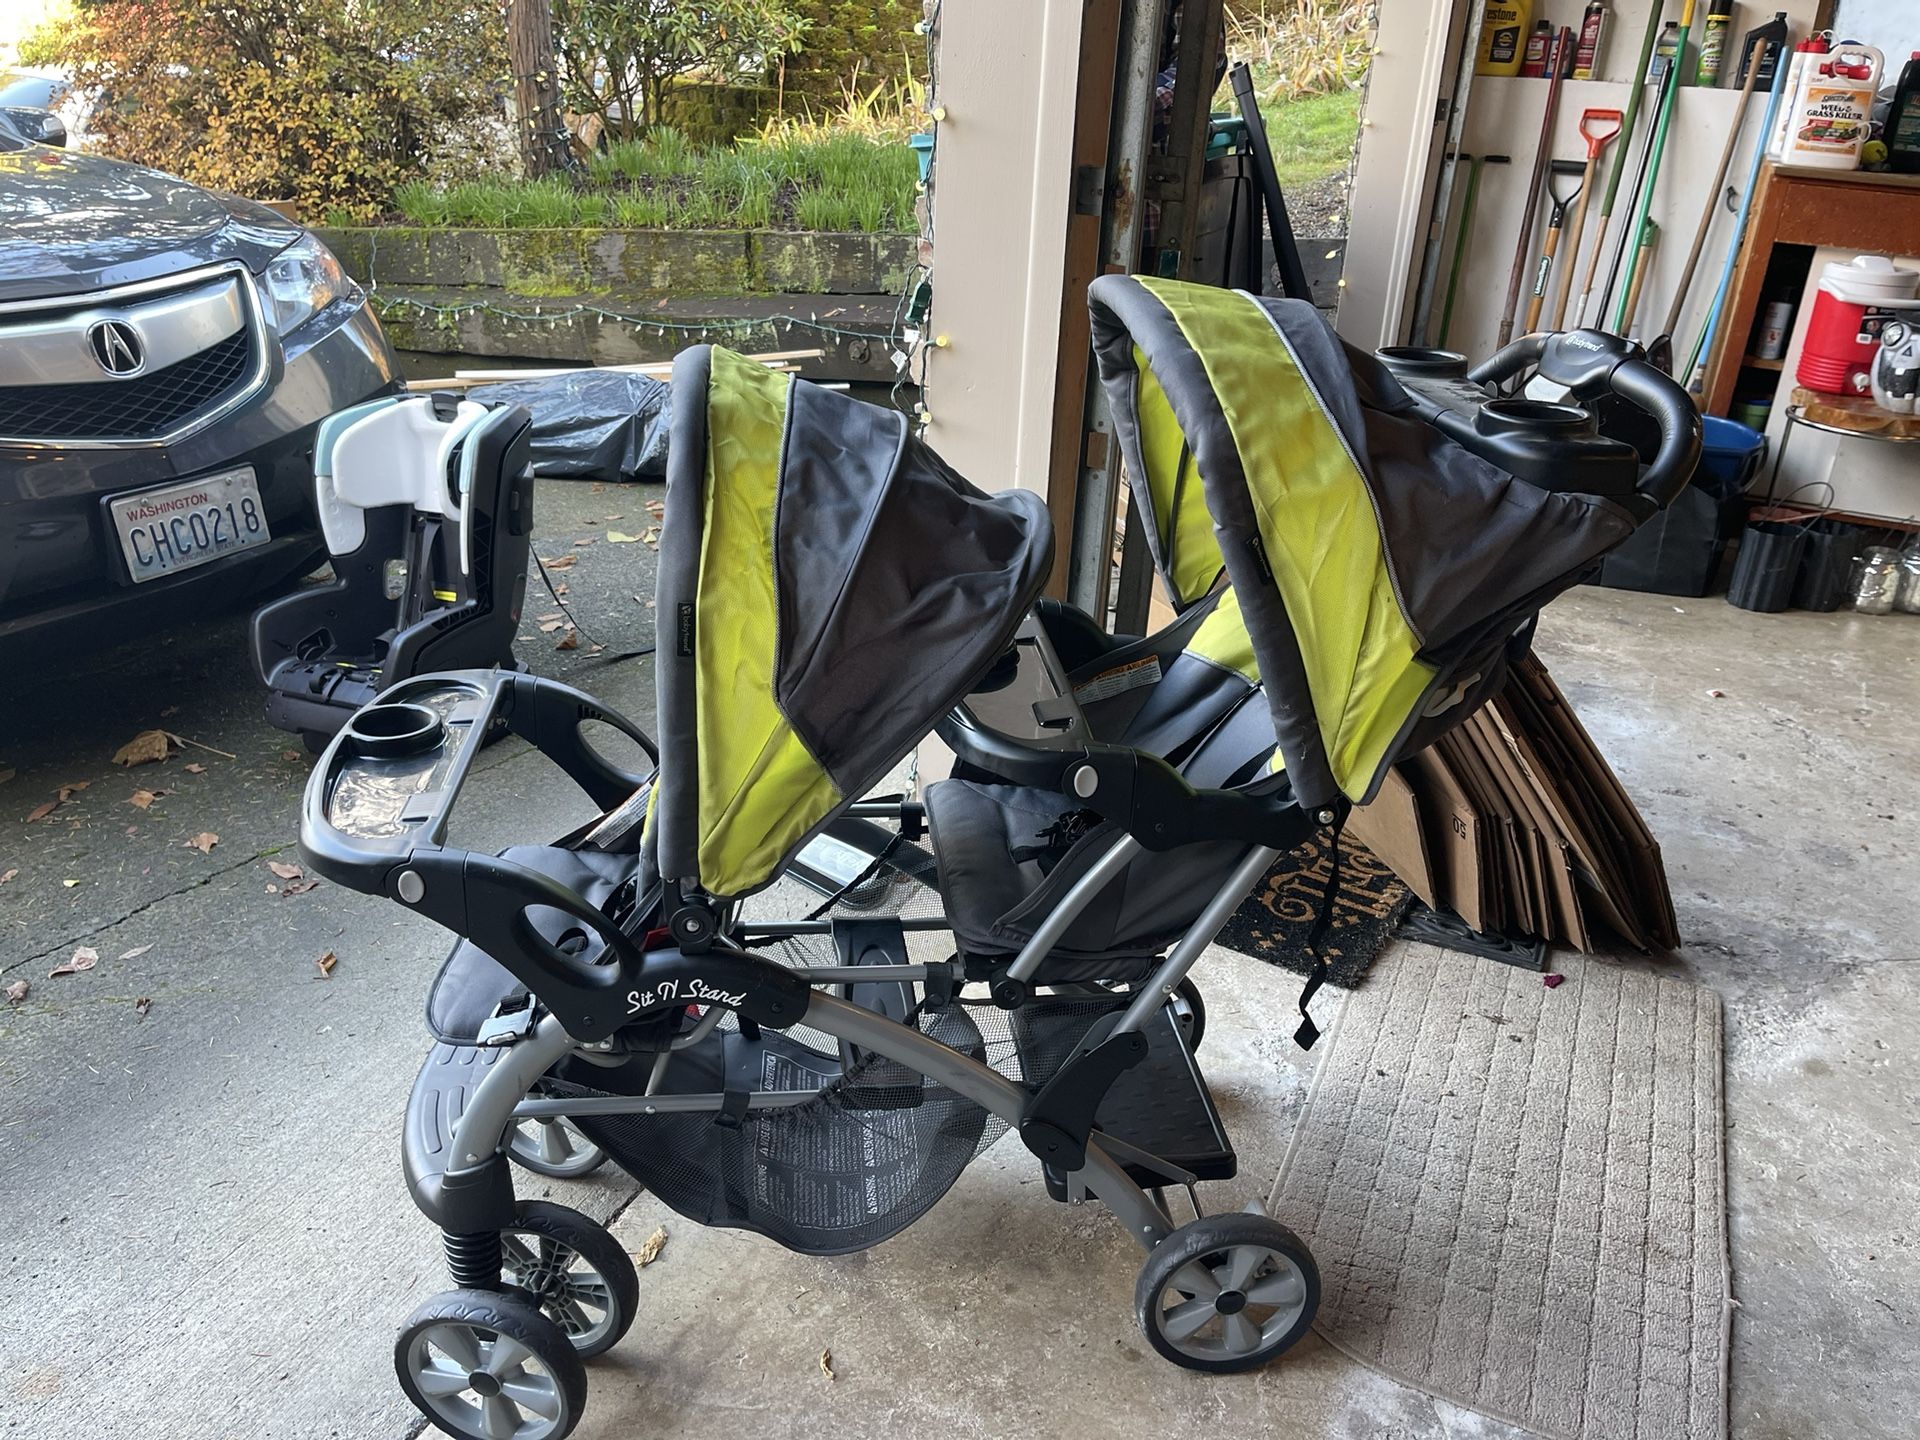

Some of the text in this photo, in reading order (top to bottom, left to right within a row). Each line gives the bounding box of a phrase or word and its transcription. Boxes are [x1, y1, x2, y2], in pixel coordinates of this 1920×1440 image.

[1807, 109, 1862, 120] GRASS KILLER
[126, 493, 208, 522] WASHINGTON
[130, 497, 260, 567] CHC0218
[172, 541, 237, 566] EVERGREEN STATE
[627, 991, 655, 1014] Sit
[681, 979, 747, 1007] Stand
